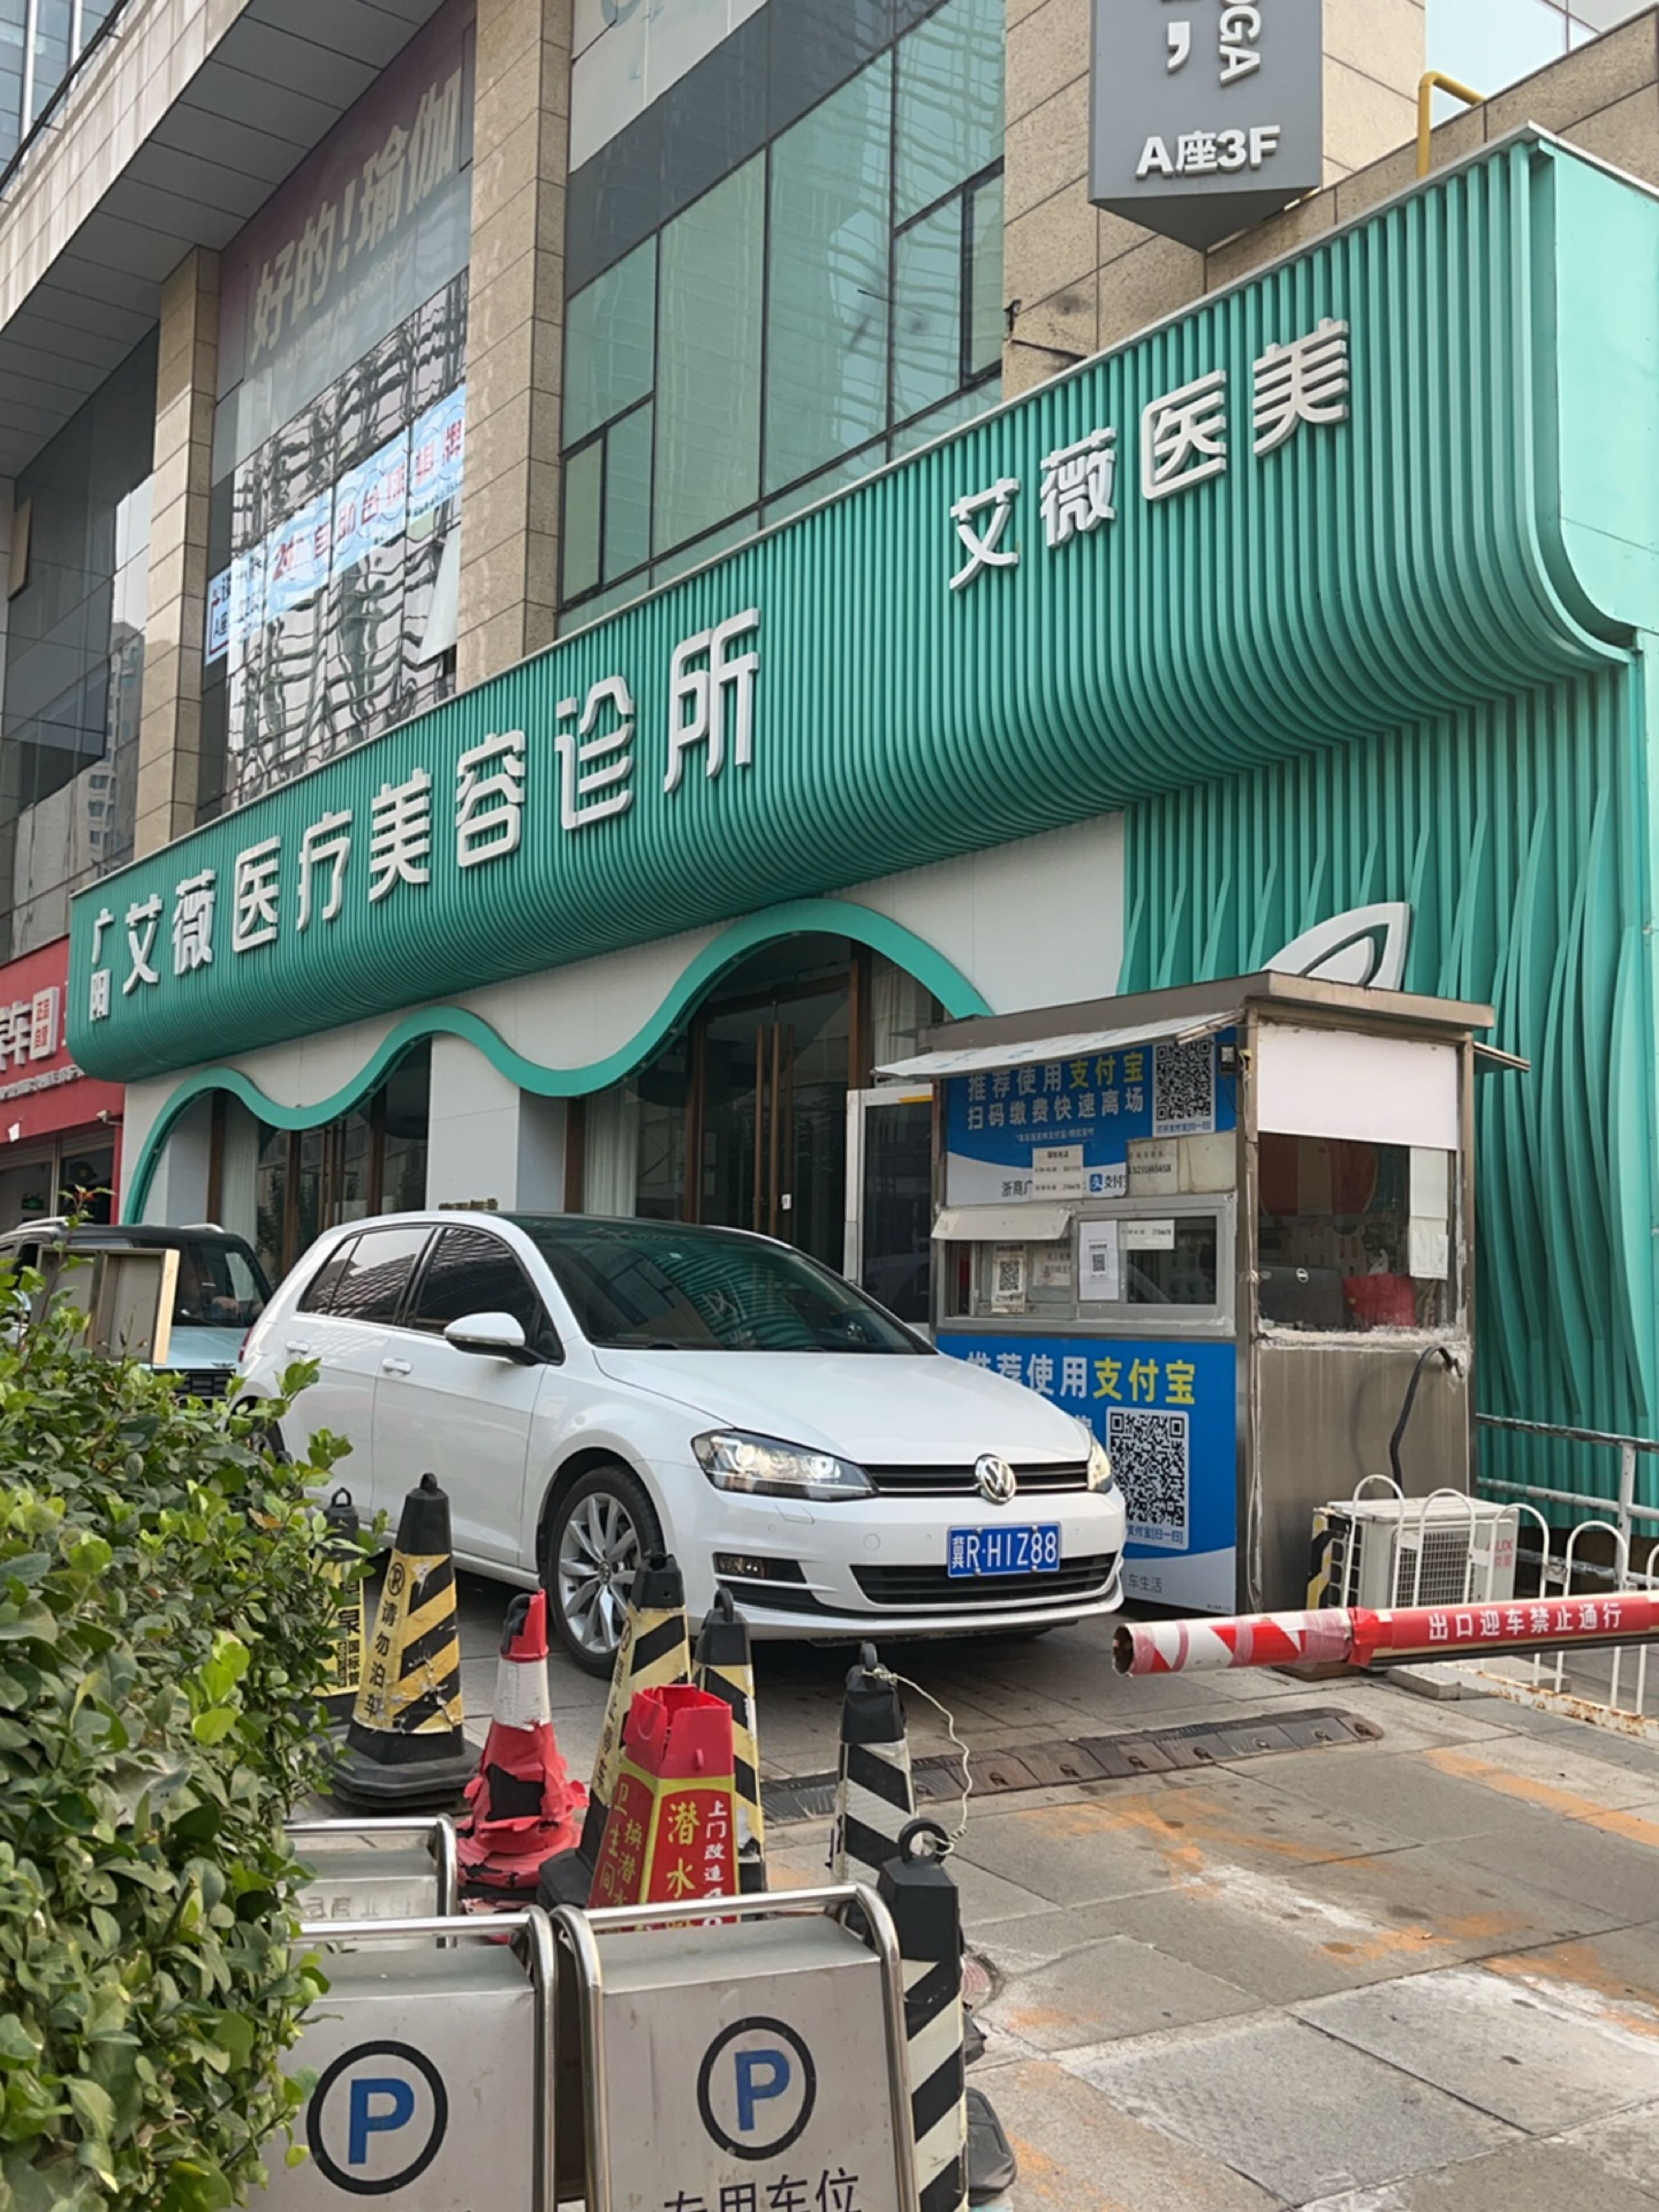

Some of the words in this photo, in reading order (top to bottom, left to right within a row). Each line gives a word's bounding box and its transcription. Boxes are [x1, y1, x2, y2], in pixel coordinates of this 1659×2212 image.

[1219, 0, 1262, 86] GA
[1135, 125, 1280, 180] A座3F
[950, 317, 1349, 590] 艾薇医美
[124, 608, 760, 995] 艾薇医疗美容诊所
[967, 1053, 1144, 1102] 推荐使用支付宝
[967, 1086, 1144, 1130] 扫码缴费快速离场
[1104, 1173, 1127, 1190] 支付
[1428, 1602, 1623, 1641] 出口迎车禁止通行
[348, 2078, 415, 2165] P
[735, 2049, 791, 2132] P
